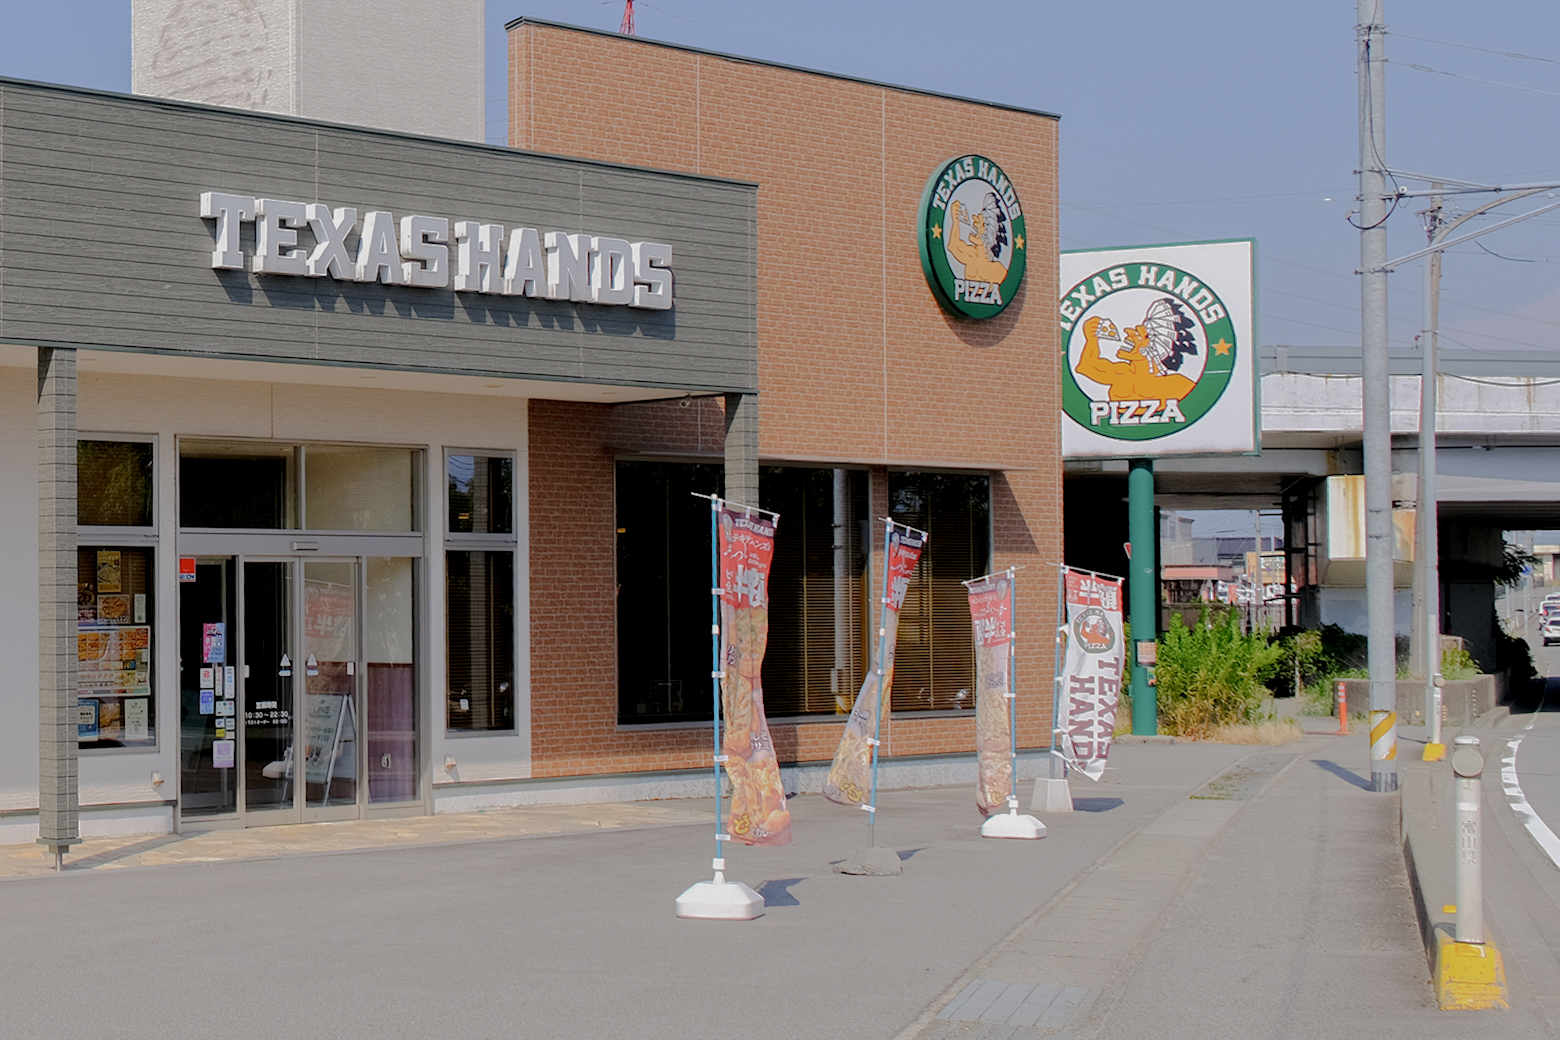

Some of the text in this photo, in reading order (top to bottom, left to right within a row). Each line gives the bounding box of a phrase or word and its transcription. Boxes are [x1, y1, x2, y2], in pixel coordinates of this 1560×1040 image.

[931, 157, 1022, 221] TEXAS HANDS
[200, 191, 674, 311] TEXAS HANDS
[953, 278, 1003, 306] PIZZA
[1137, 264, 1228, 326] HANDS
[1089, 398, 1187, 426] PIZZA
[1079, 578, 1118, 610] 半額
[1084, 642, 1108, 650] PIZZA
